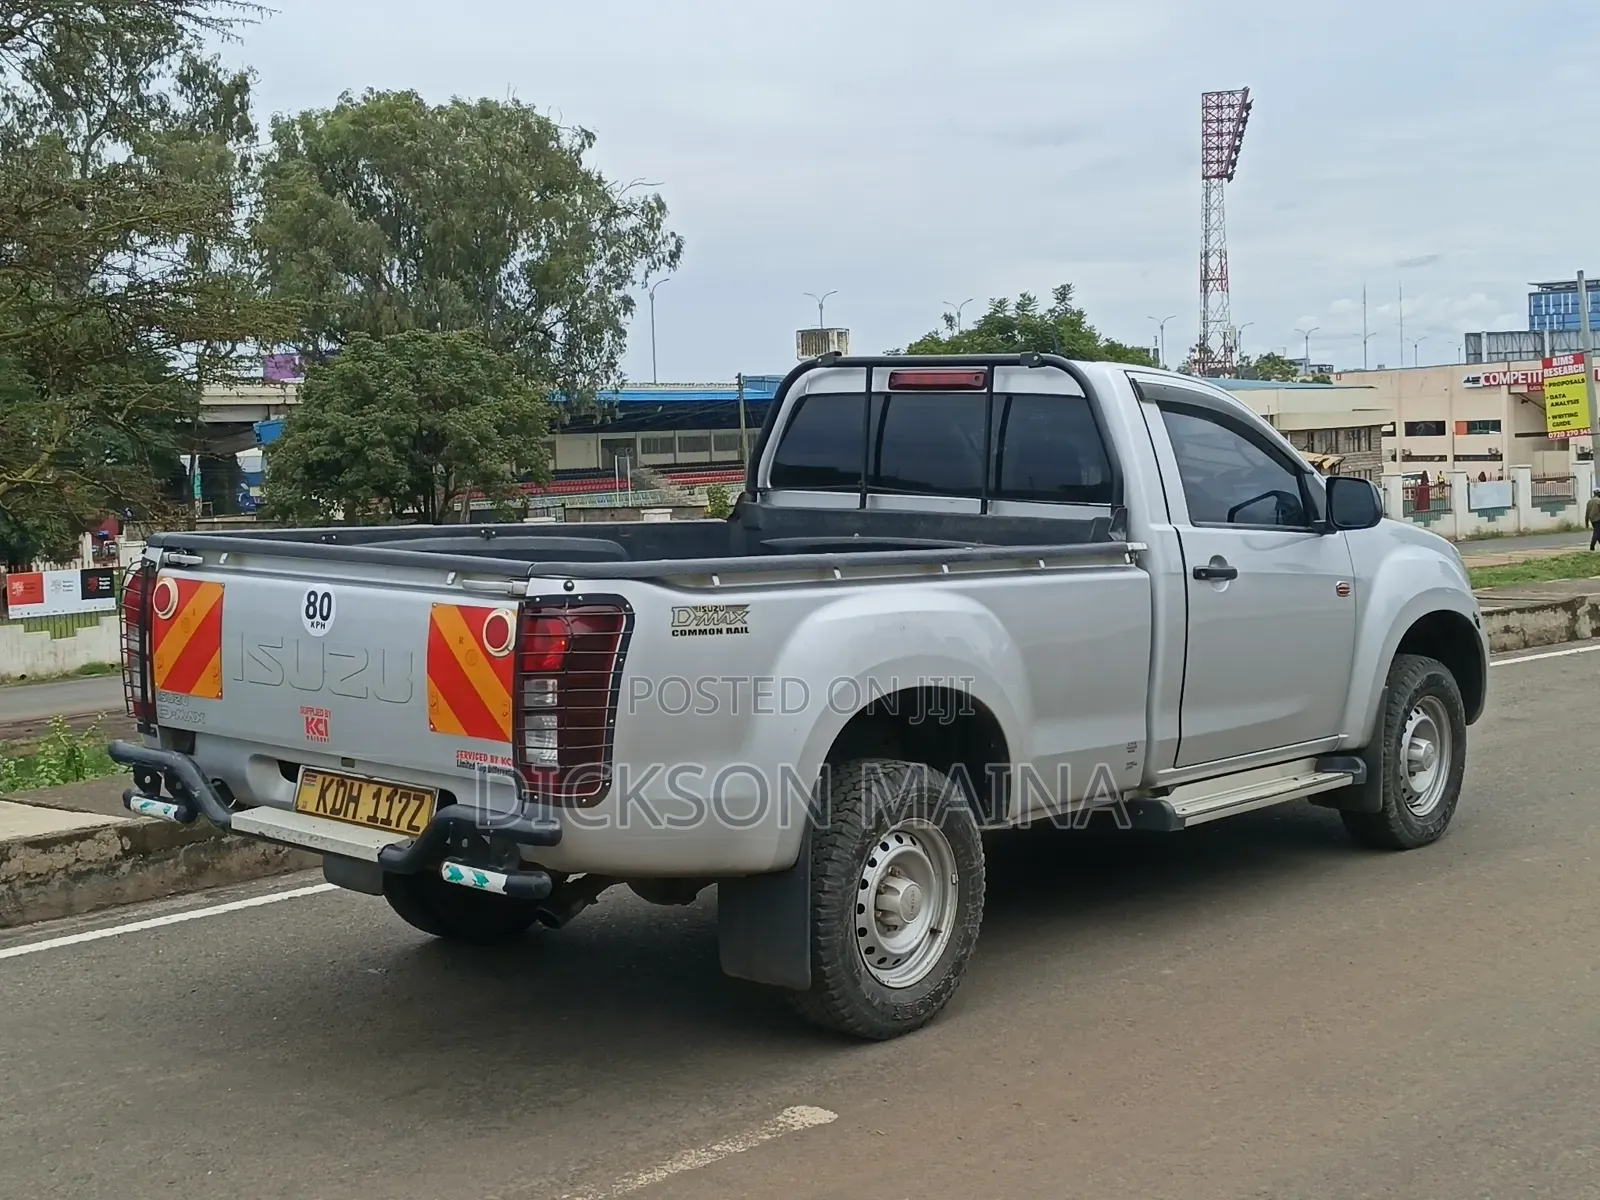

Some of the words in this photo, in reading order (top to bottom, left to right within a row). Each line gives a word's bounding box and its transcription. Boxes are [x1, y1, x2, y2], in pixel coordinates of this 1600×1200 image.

[1552, 355, 1574, 367] AIMS
[1544, 363, 1585, 377] RESEARCH
[1482, 370, 1543, 386] COMPETIT
[1549, 378, 1585, 388] PROPOSALS
[1550, 399, 1580, 407] ANALYSIS
[1551, 412, 1578, 420] WRITING
[305, 590, 332, 621] 80
[310, 621, 326, 630] KPH
[672, 628, 723, 637] COMMON
[726, 626, 749, 634] RAIL
[233, 631, 413, 703] ISUZU
[300, 705, 324, 717] SUPPLIED
[305, 716, 329, 737] KCI
[456, 750, 488, 762] SERVICED
[490, 755, 499, 764] BY
[315, 776, 362, 819] KDH
[366, 787, 425, 832] 117Z
